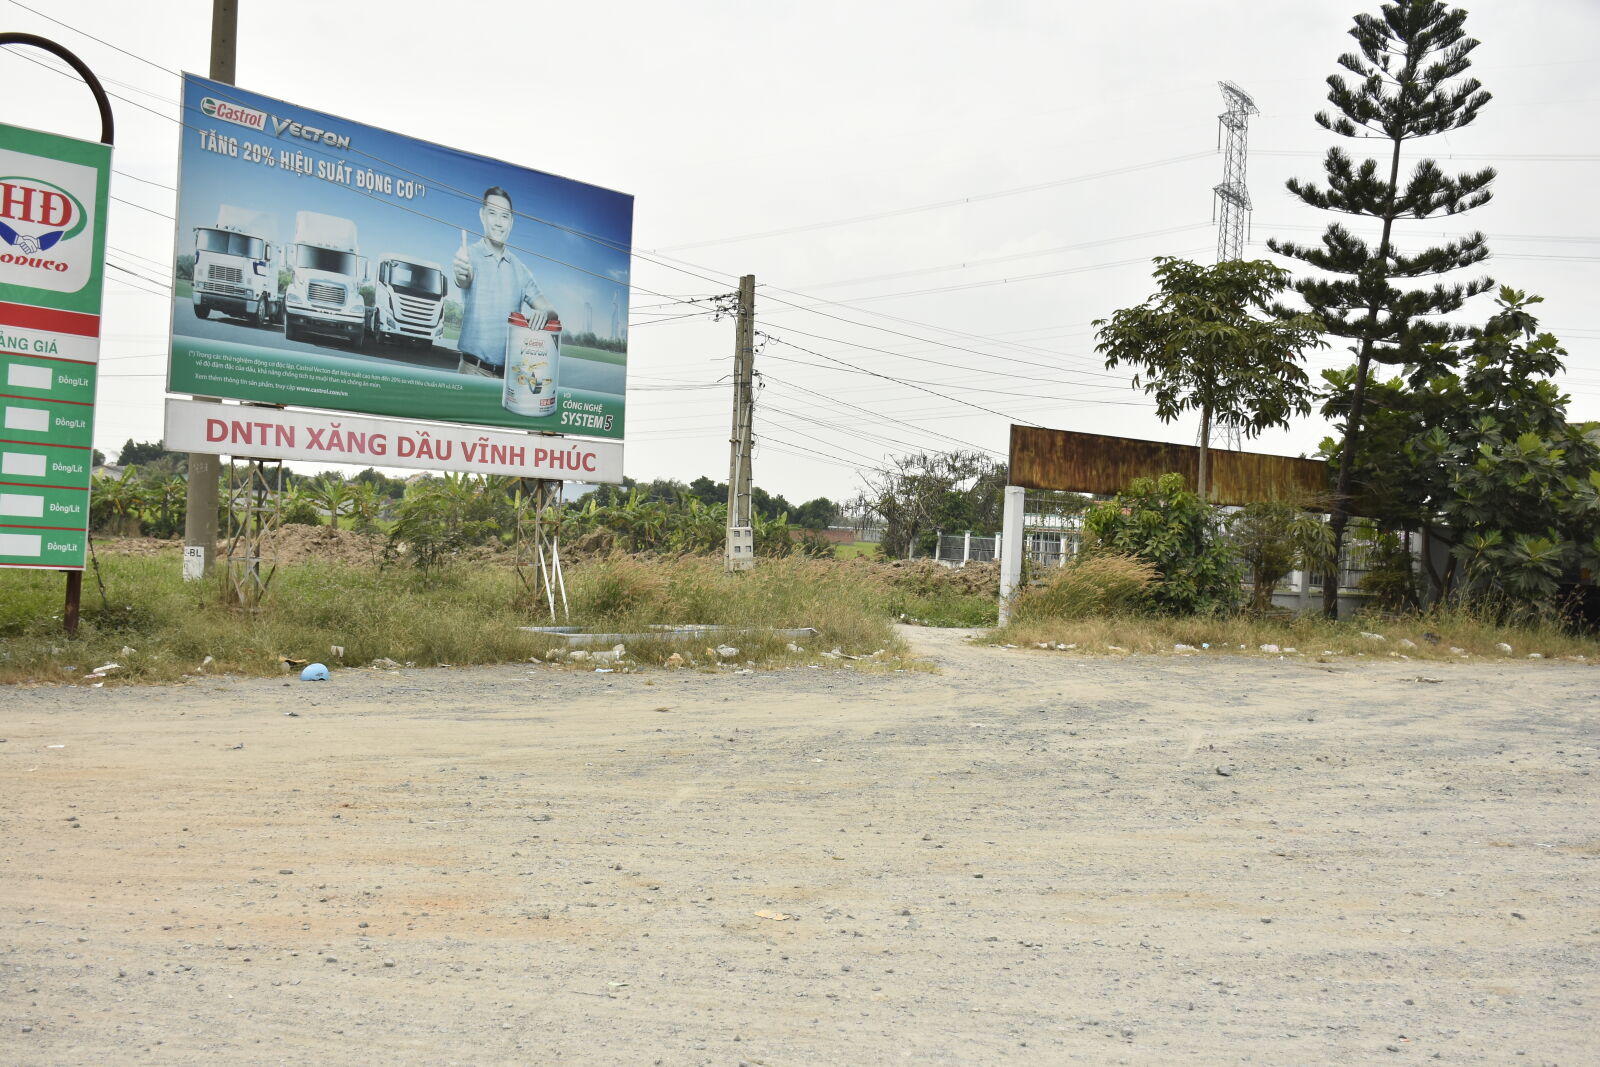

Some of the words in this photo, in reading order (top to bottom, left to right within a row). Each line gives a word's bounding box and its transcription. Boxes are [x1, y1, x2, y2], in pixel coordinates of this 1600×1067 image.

[217, 103, 263, 127] Castrol
[199, 128, 238, 158] TĂNG
[243, 141, 275, 167] 20%
[280, 150, 313, 177] HIỆU
[317, 159, 353, 185] SUẤT
[356, 168, 392, 195] ĐỘNG
[33, 338, 58, 354] GIÁ
[562, 399, 583, 411] CÔNG
[583, 402, 604, 415] NGHỆ
[560, 410, 605, 429] SYSTEM
[603, 414, 614, 432] 5
[206, 418, 296, 449] DNTN
[305, 422, 388, 456] XĂNG
[397, 430, 453, 462] DẦU
[460, 436, 526, 467] VĨNH
[533, 444, 597, 473] PHÚC
